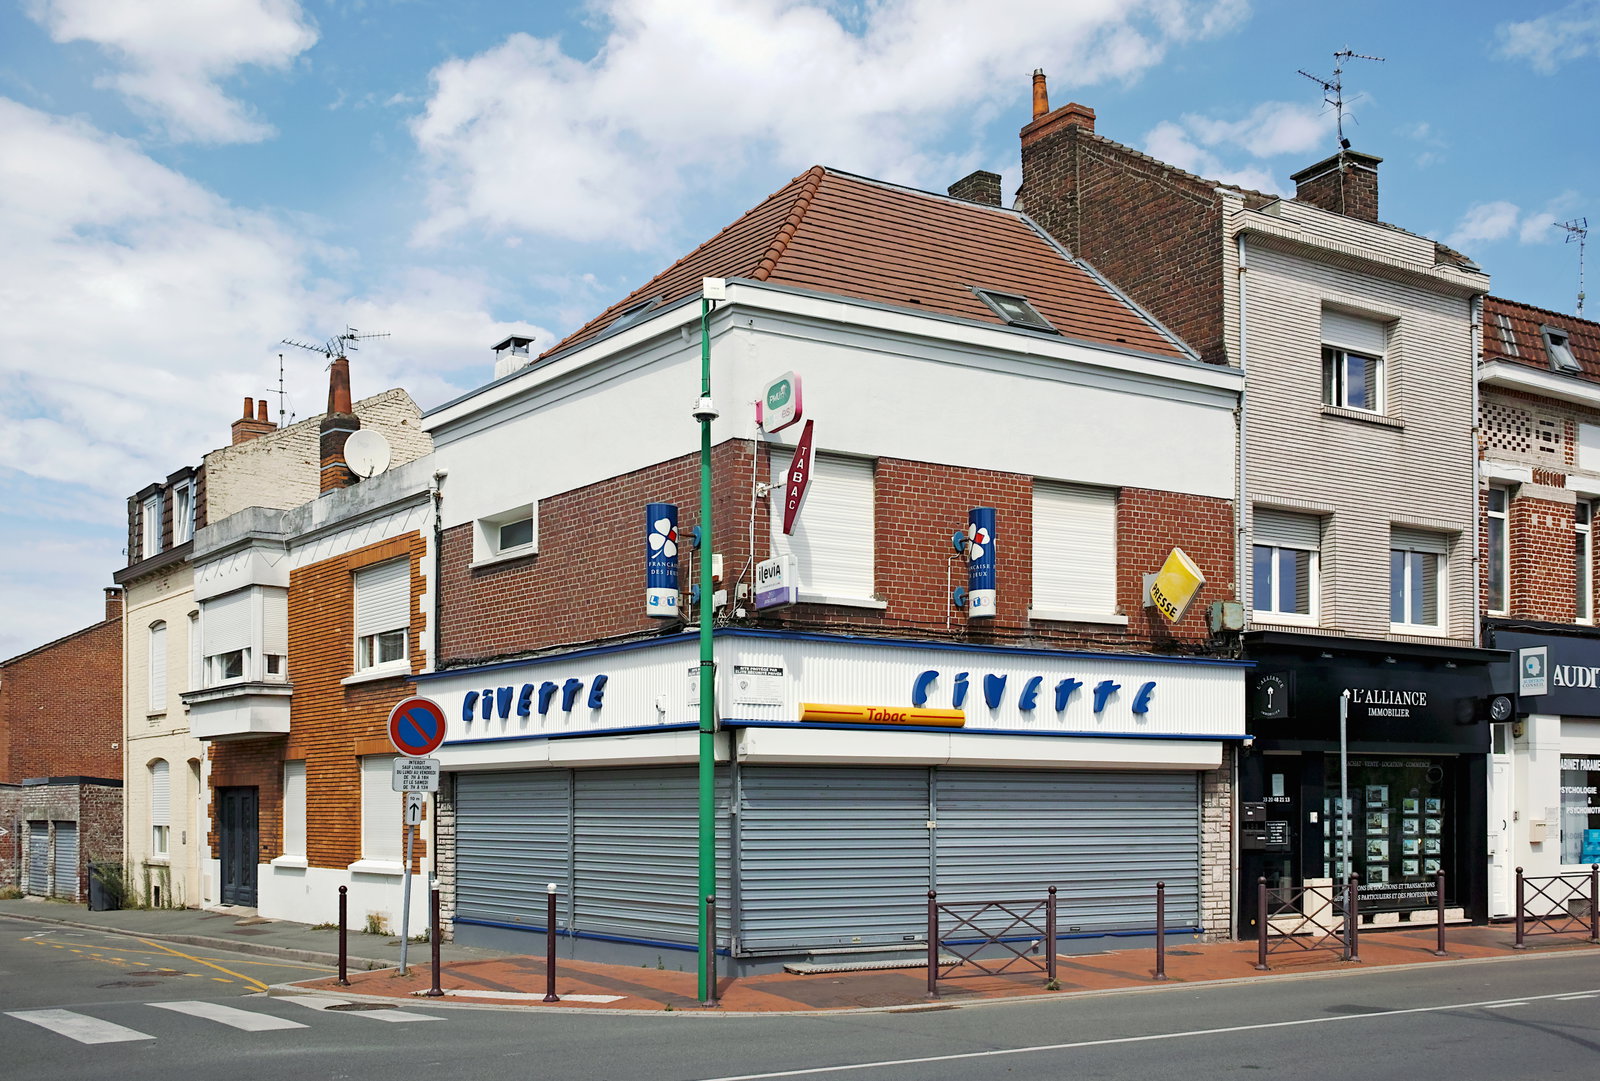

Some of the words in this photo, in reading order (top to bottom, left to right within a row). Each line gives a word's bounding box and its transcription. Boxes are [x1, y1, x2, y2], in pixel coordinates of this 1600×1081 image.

[789, 447, 807, 510] TABAC
[1152, 583, 1178, 617] PRESSE
[1353, 688, 1427, 706] L'ALLIANCE
[867, 708, 907, 722] Tabac
[1368, 707, 1410, 717] IMMOBILIER
[1560, 759, 1580, 771] ABINET
[1560, 786, 1598, 794] SYCHOLOGIE
